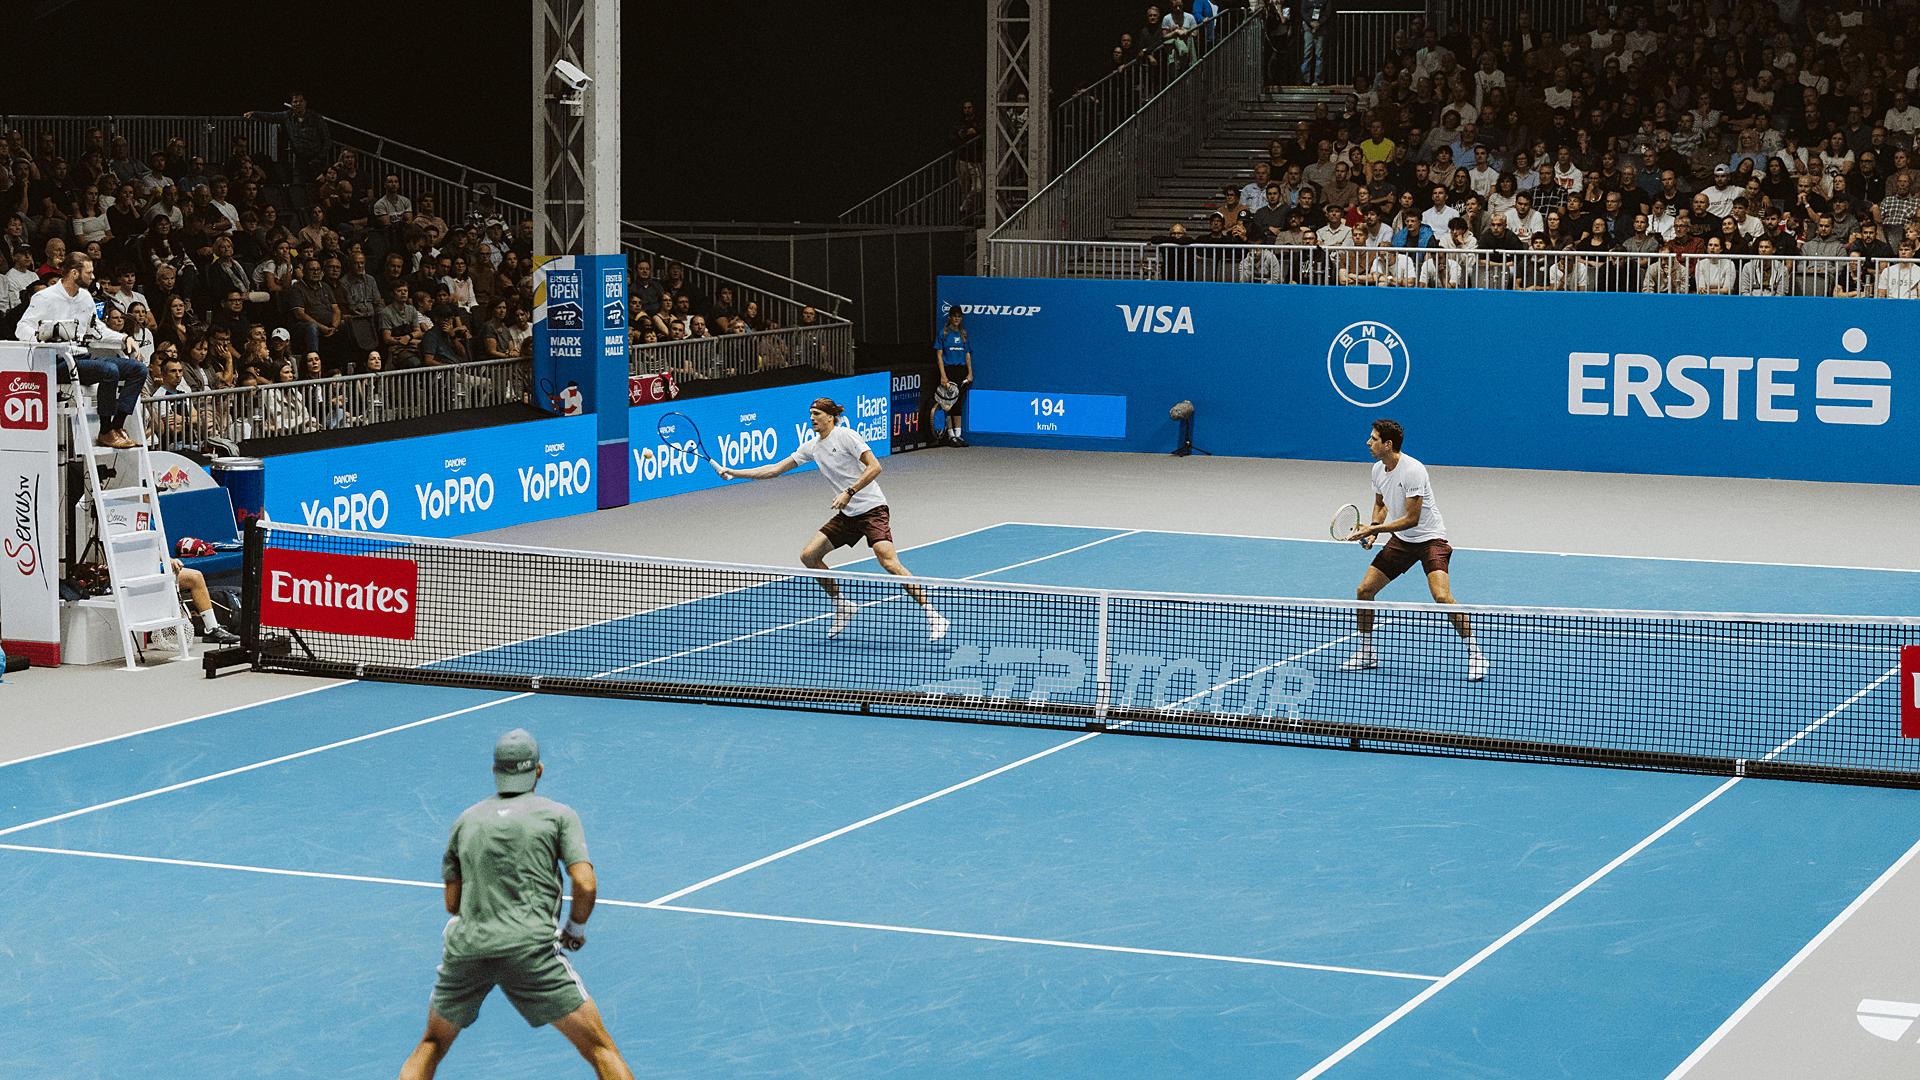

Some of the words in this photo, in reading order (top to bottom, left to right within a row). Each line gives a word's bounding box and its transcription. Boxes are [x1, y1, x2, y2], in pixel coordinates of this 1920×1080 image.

[550, 284, 578, 298] OPEN
[606, 283, 622, 298] OPEN
[554, 311, 576, 320] ATP
[607, 310, 621, 319] ATP
[960, 304, 1041, 316] DUNLOP
[1116, 304, 1195, 334] VISA
[550, 336, 581, 346] MARX
[605, 335, 623, 345] MARX
[550, 347, 581, 357] HALLE
[605, 346, 623, 356] HALLE
[892, 374, 921, 392] RADO
[1568, 352, 1799, 423] ERSTE
[857, 395, 887, 418] Haare
[1030, 398, 1065, 417] 194
[857, 422, 882, 442] Glatze
[1037, 422, 1057, 431] km/h
[718, 427, 777, 468] YoPRO
[633, 440, 698, 482] YoPRO
[518, 458, 590, 502] YoPRO
[415, 473, 494, 520] YoPRO
[301, 490, 389, 539] YoPRO
[270, 570, 409, 613] Emirates
[913, 645, 1086, 707] ATP
[1118, 651, 1314, 727] TOUR
